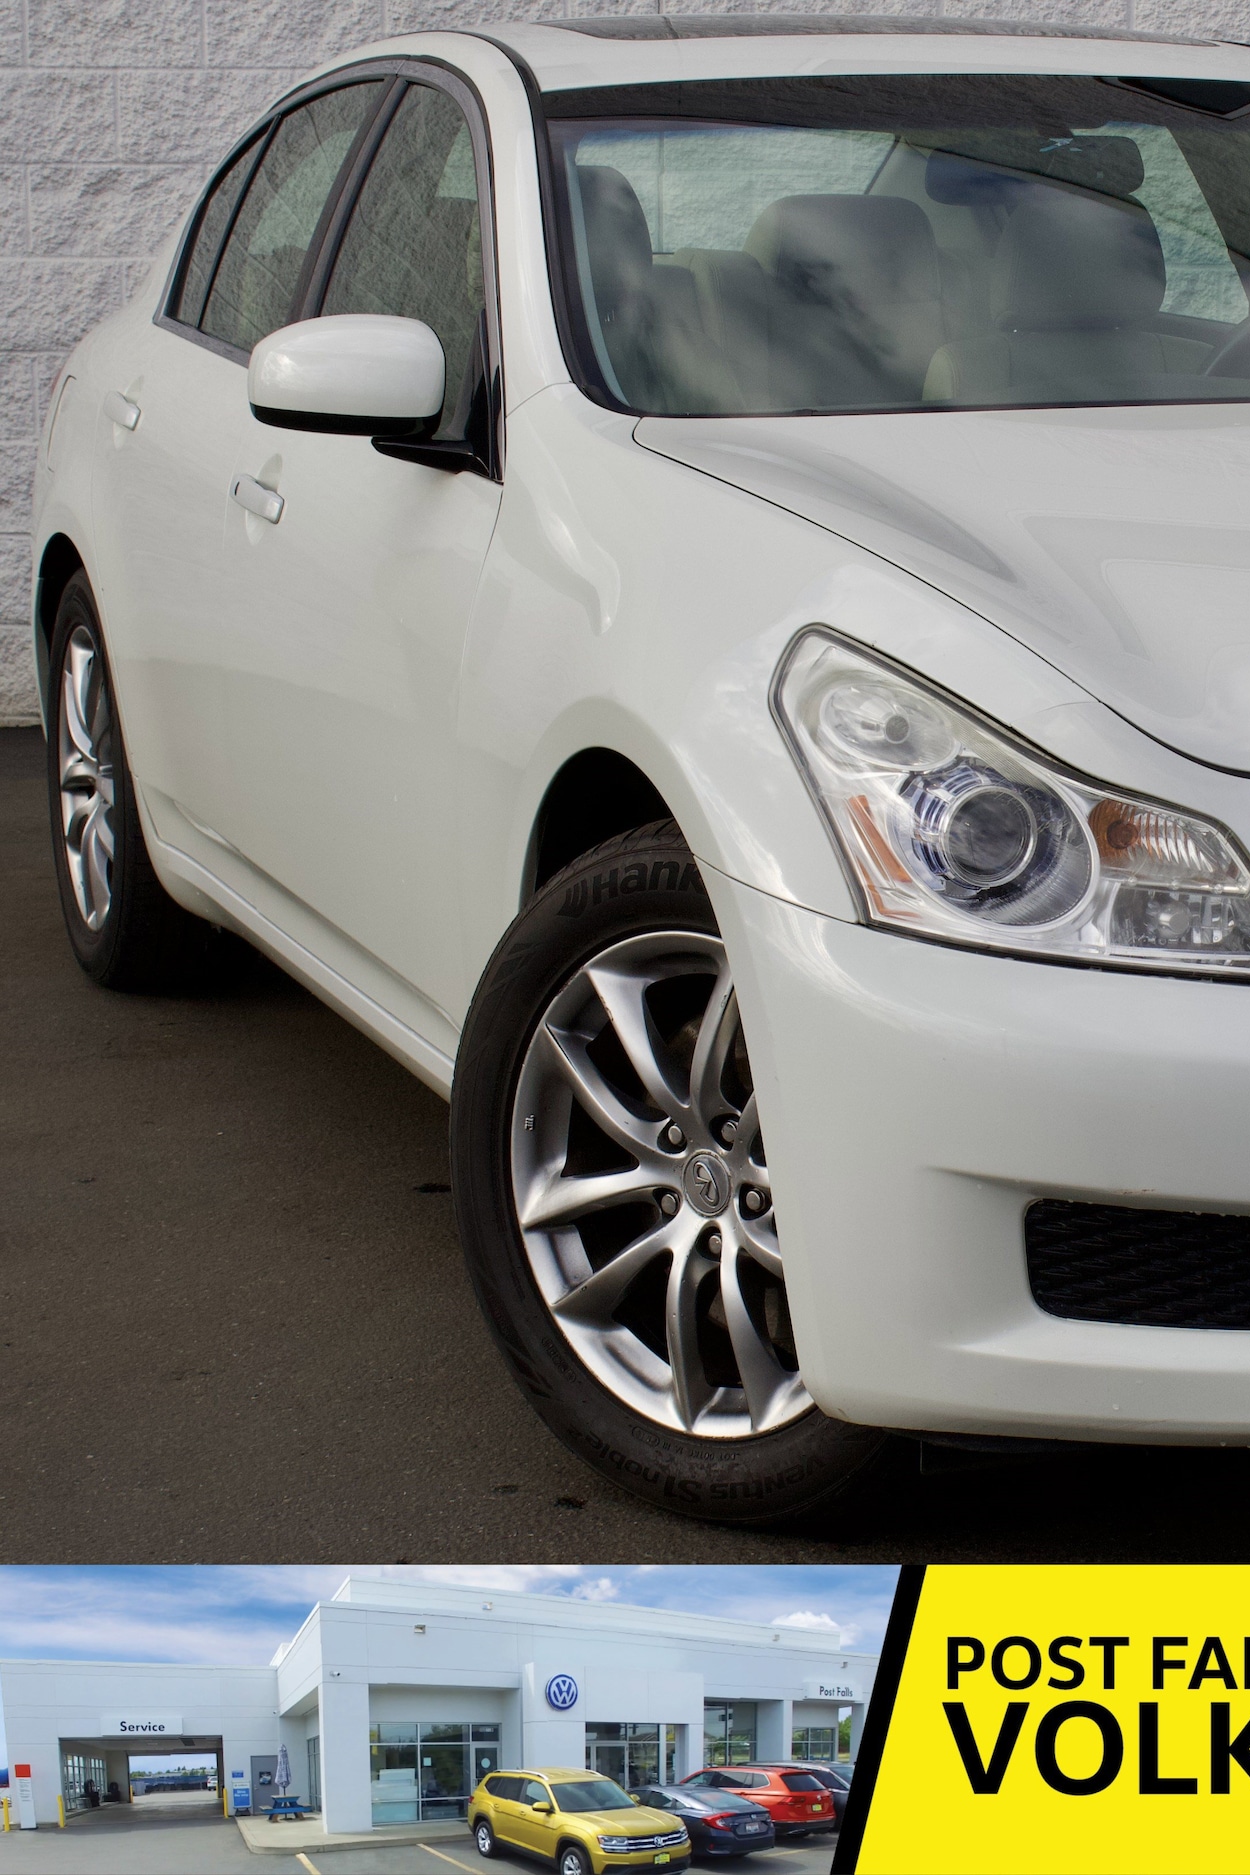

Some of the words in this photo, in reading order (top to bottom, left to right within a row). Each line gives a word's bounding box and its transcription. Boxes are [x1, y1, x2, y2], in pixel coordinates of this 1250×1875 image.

[819, 1686, 835, 1697] Post
[836, 1687, 853, 1697] Falls
[120, 1721, 165, 1732] Service
